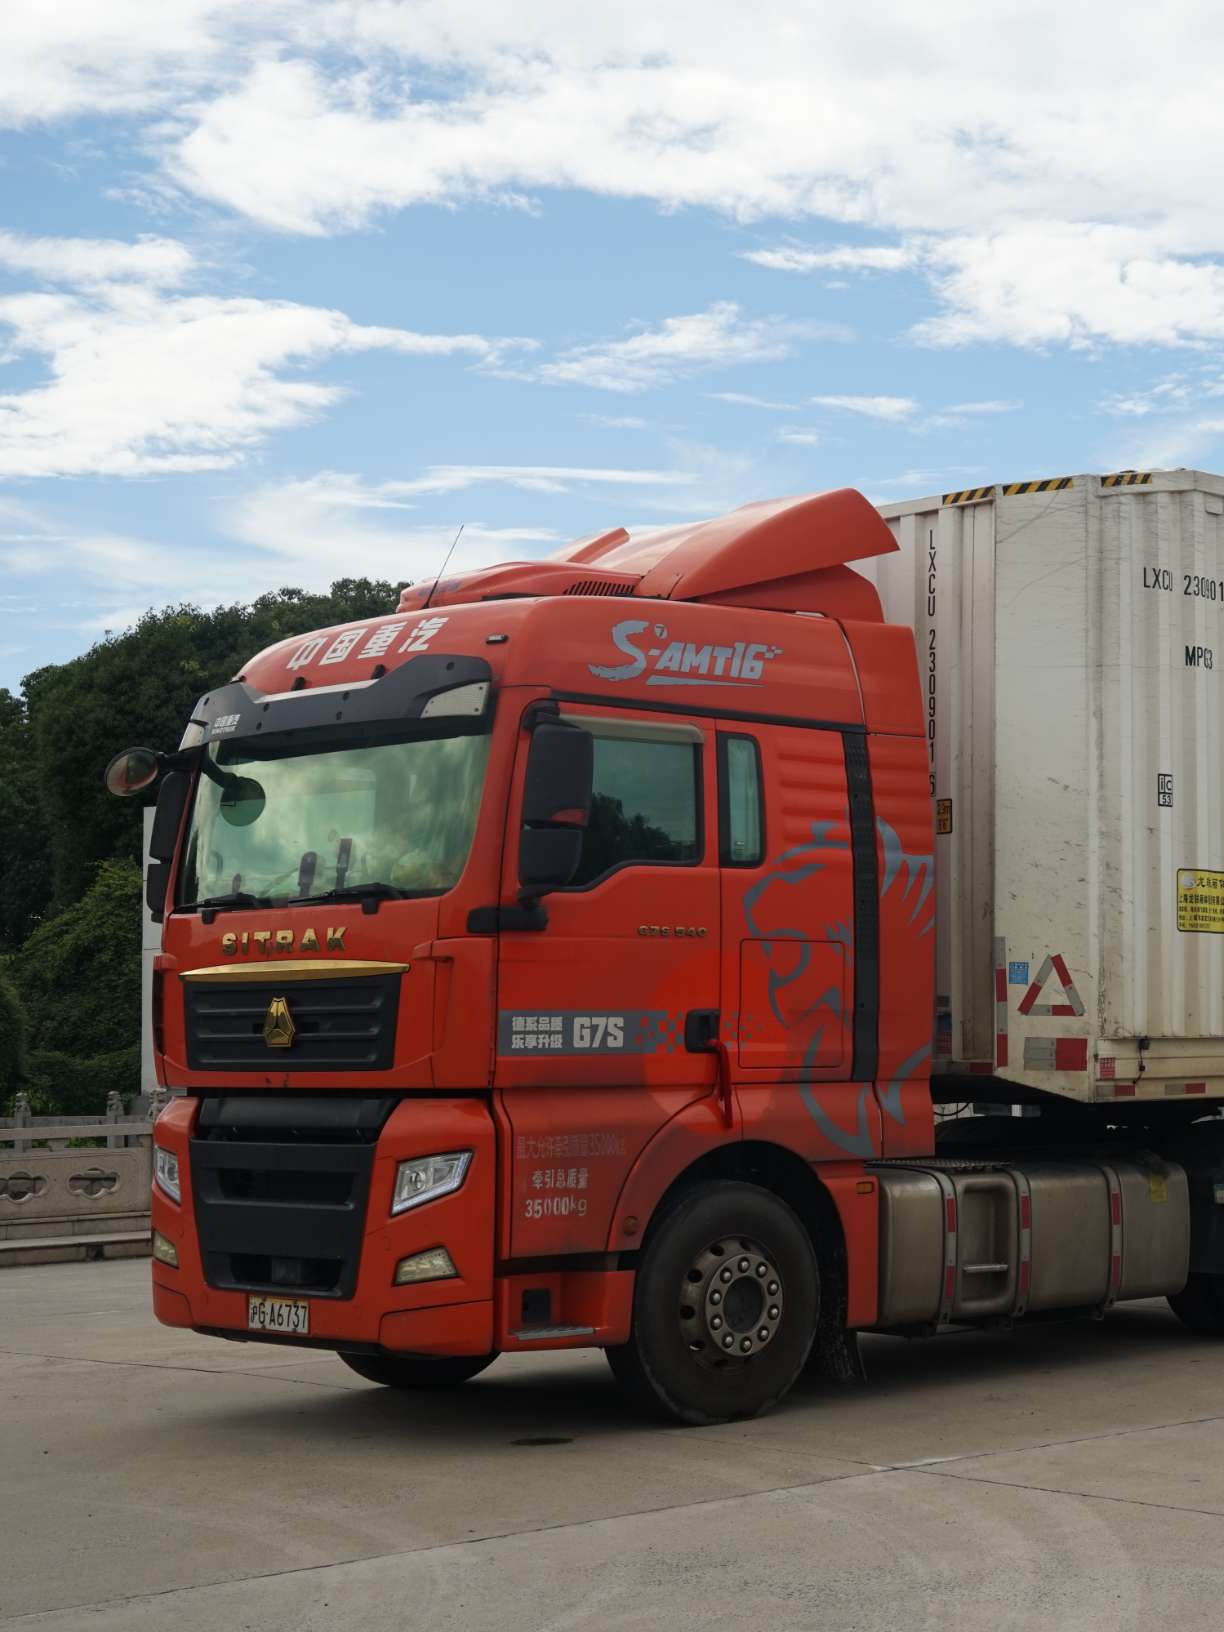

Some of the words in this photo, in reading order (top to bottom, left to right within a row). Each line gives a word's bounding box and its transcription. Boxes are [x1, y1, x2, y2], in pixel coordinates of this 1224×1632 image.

[927, 529, 937, 617] LXCU
[1143, 566, 1173, 592] LXCU
[1183, 574, 1224, 602] 230901
[286, 617, 449, 671] 中国重汽
[928, 628, 937, 764] 230901
[222, 927, 347, 956] SITRAK
[573, 1016, 625, 1048] G7S
[532, 1167, 589, 1190] 牵引总质量
[524, 1195, 588, 1219] 35000kg
